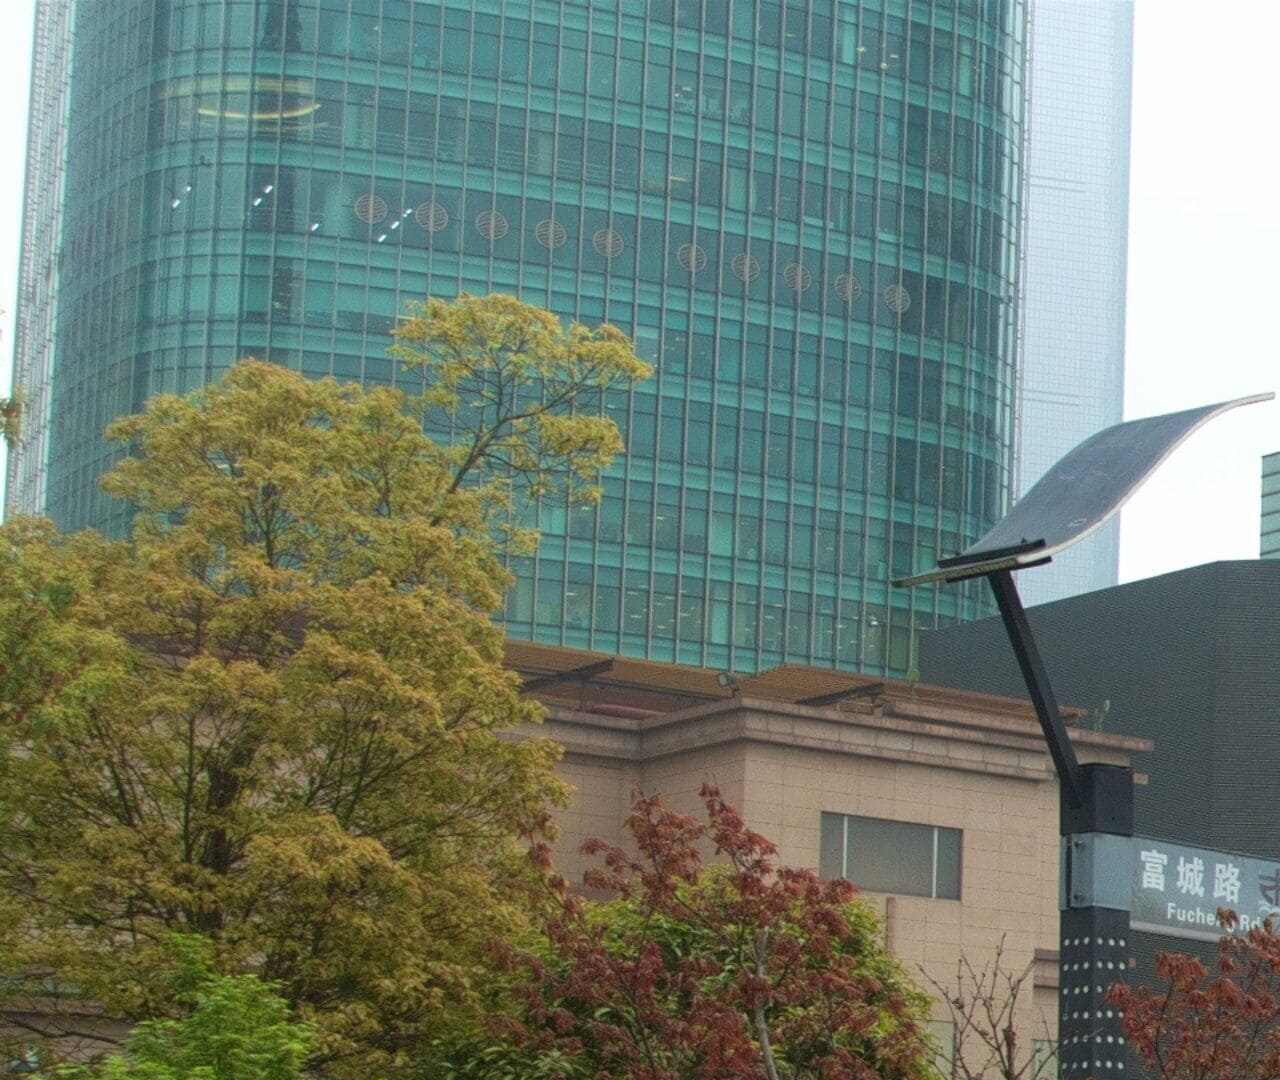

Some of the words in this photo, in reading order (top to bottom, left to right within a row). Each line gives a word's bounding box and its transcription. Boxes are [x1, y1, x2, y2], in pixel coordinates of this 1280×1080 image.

[1140, 849, 1241, 904] 富城路
[1167, 902, 1236, 933] Fuche
